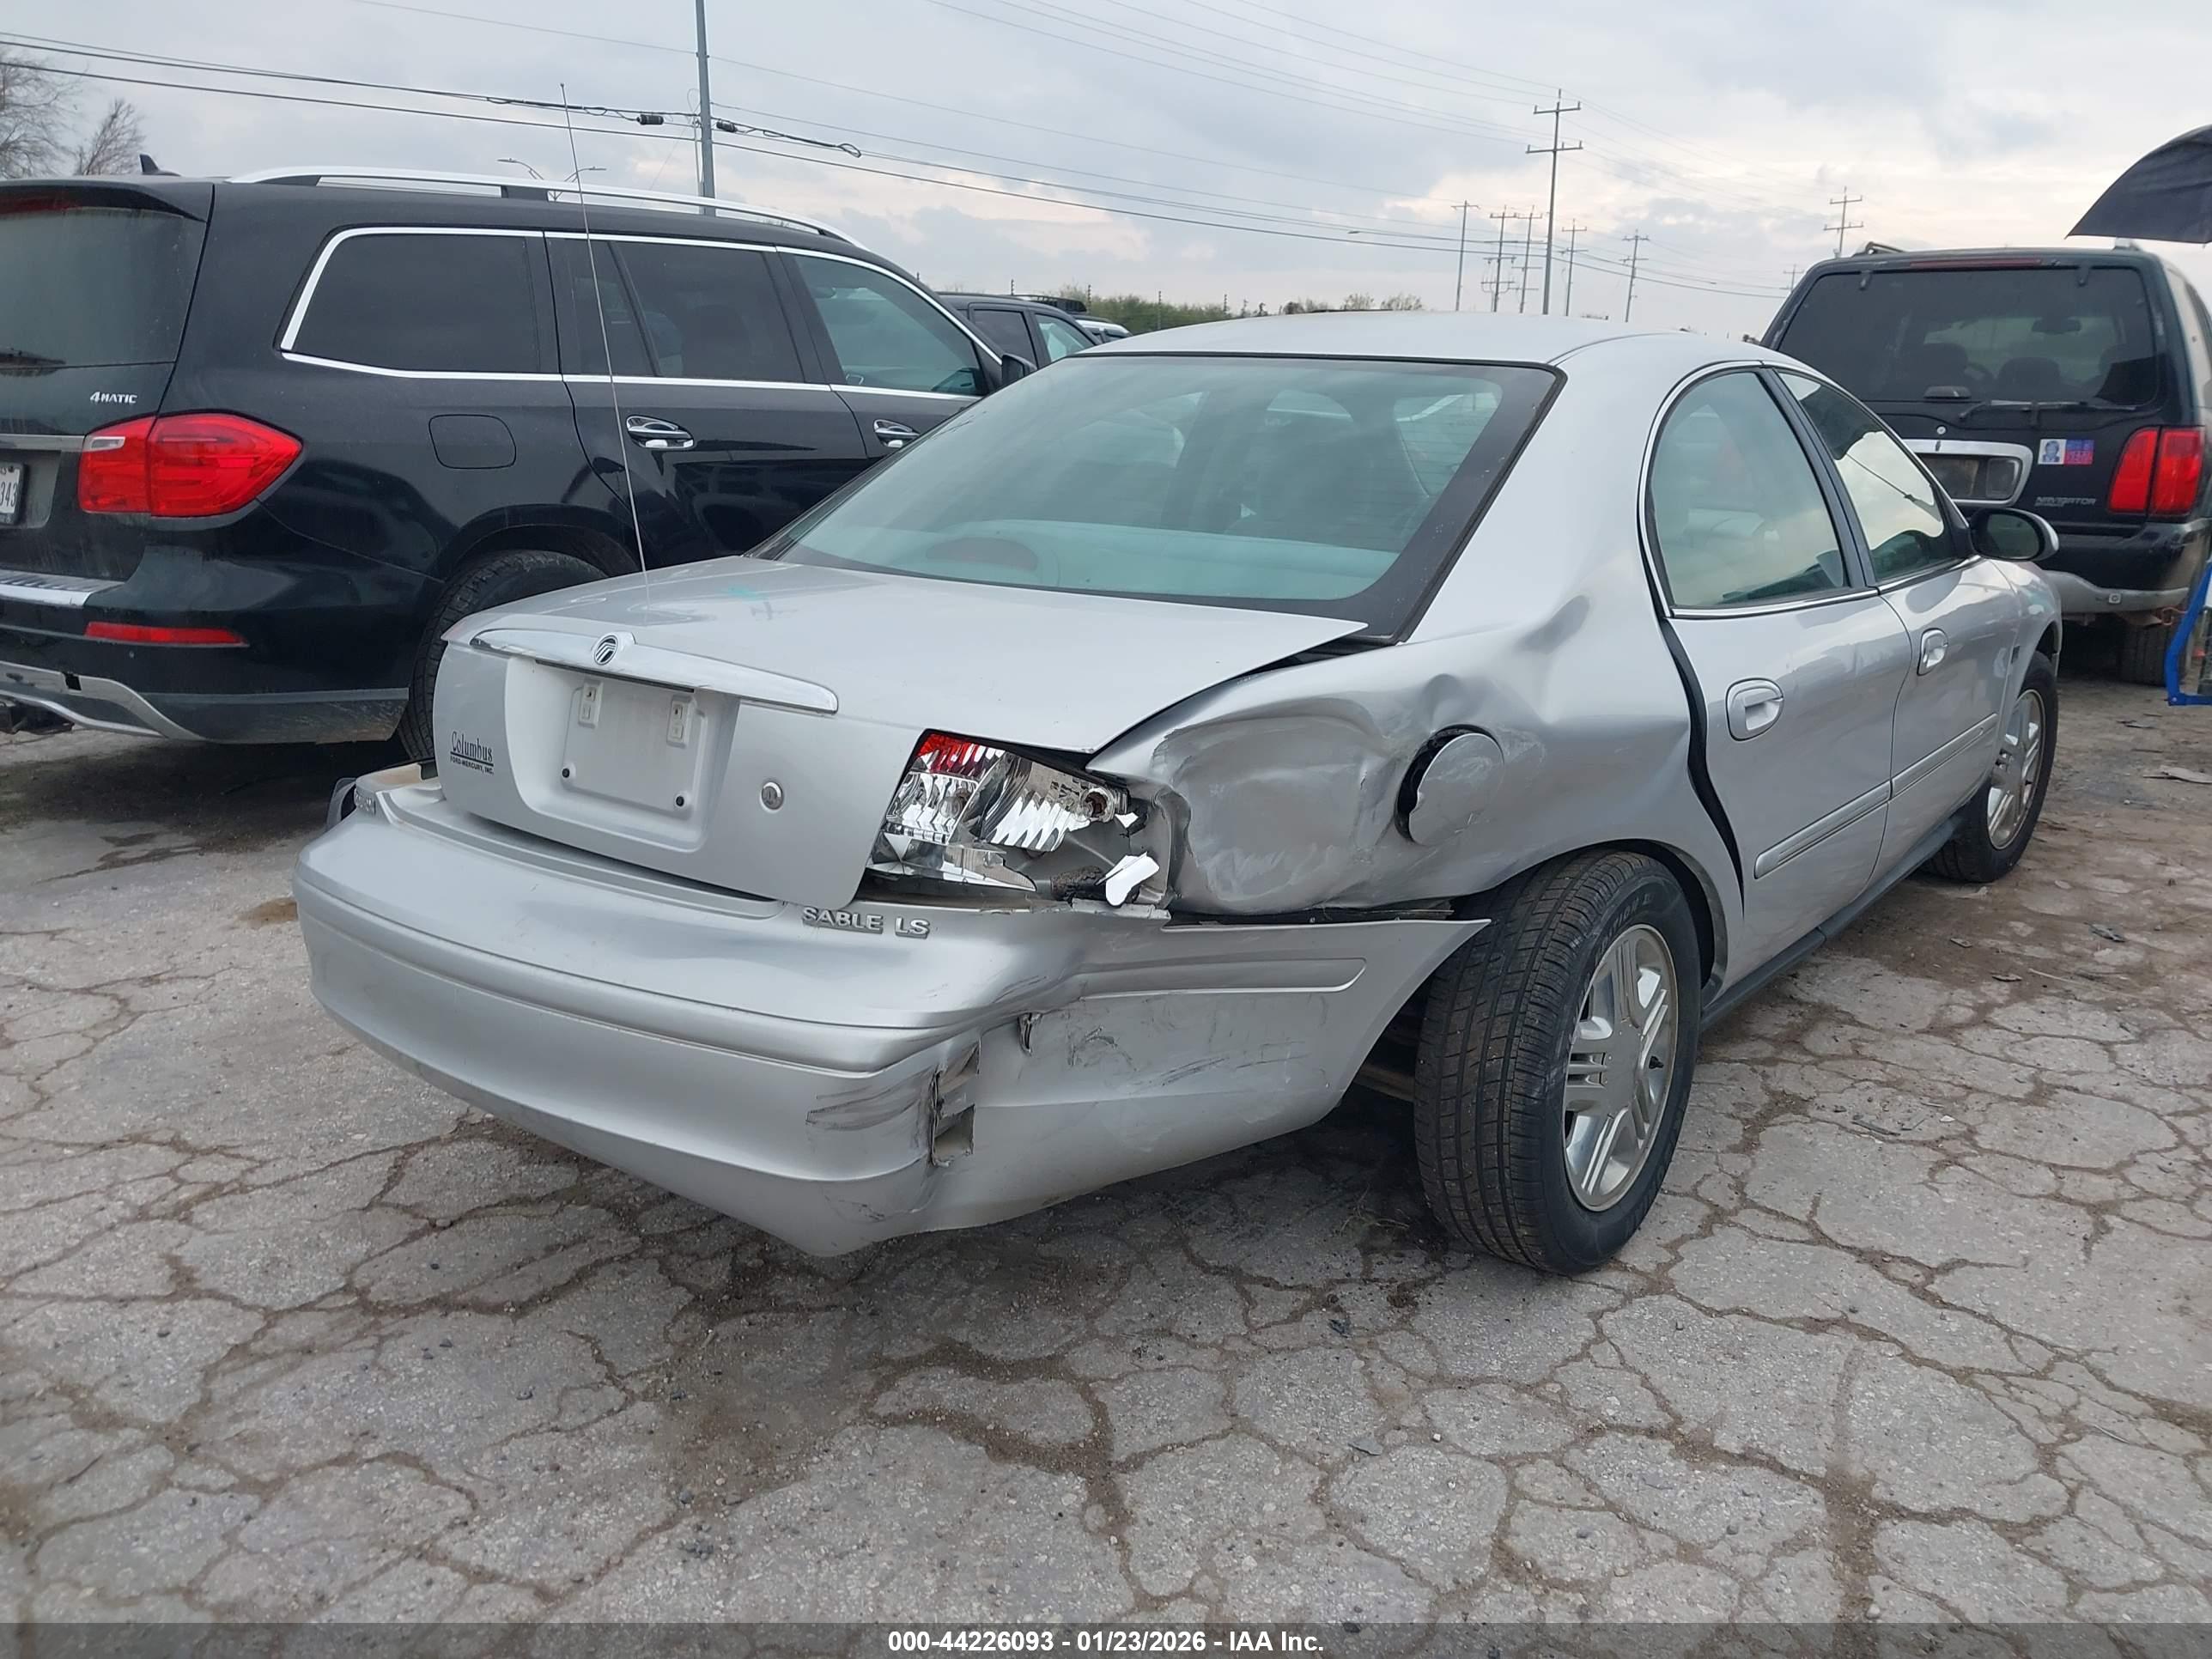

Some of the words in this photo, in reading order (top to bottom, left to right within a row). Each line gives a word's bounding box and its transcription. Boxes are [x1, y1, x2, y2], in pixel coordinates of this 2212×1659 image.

[89, 391, 138, 404] 4MATIC
[452, 731, 493, 763] Columbus
[802, 906, 884, 933] SABLE
[896, 915, 930, 939] LS
